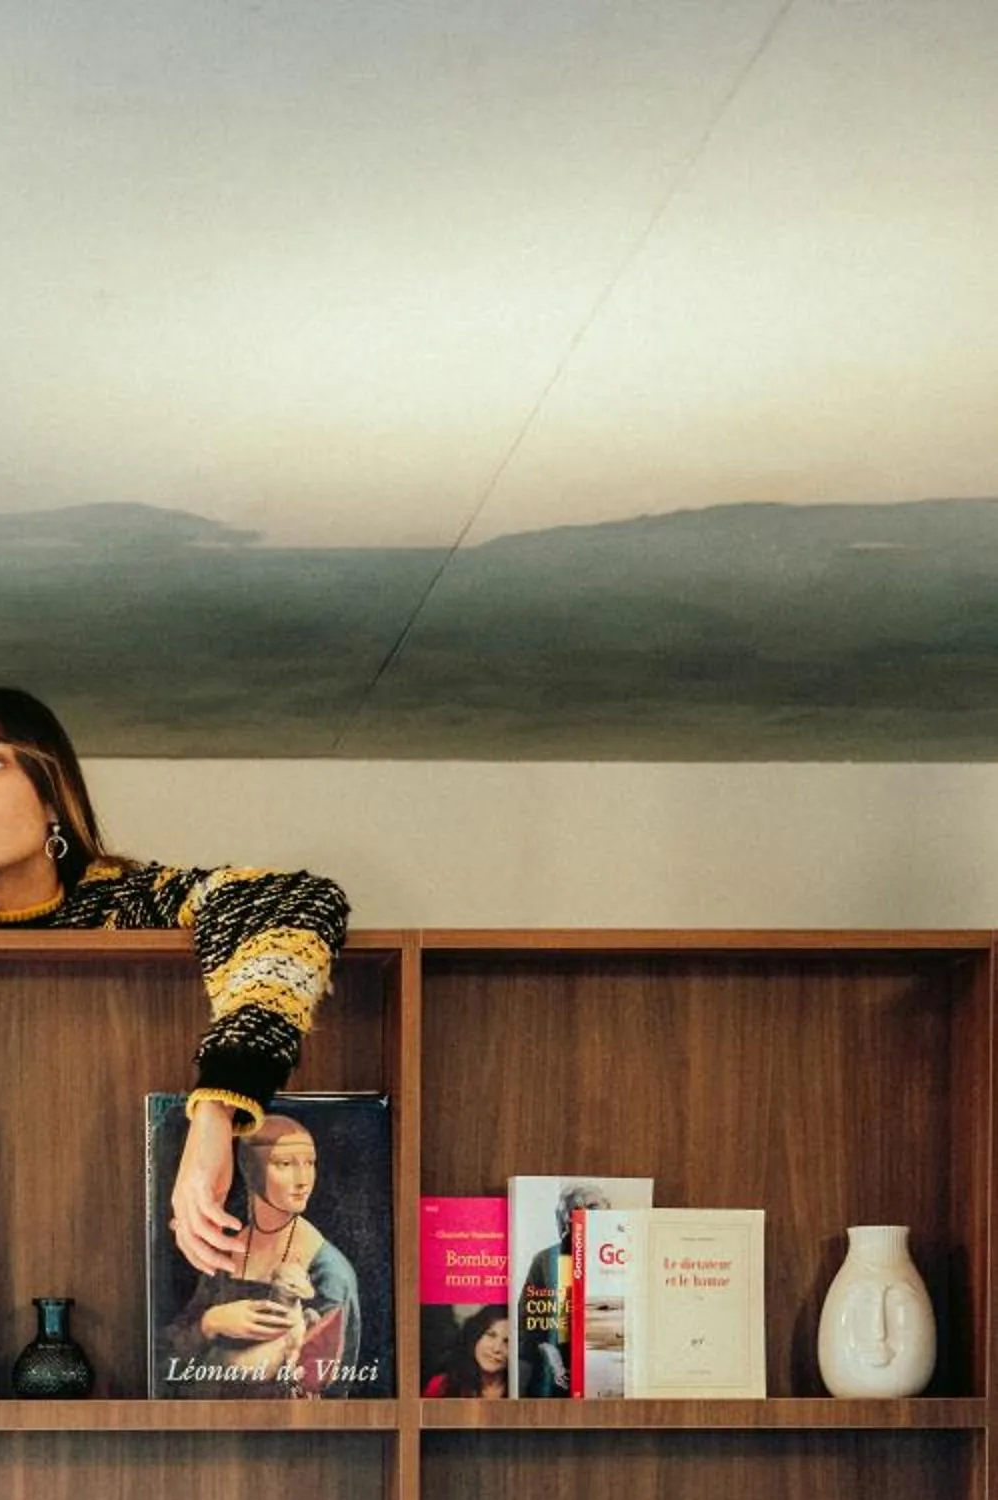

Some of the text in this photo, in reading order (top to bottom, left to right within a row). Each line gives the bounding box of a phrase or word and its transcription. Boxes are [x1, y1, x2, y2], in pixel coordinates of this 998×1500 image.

[445, 1249, 508, 1273] Bombay
[445, 1274, 481, 1287] mon
[165, 1357, 379, 1383] Léonard de Vinci
